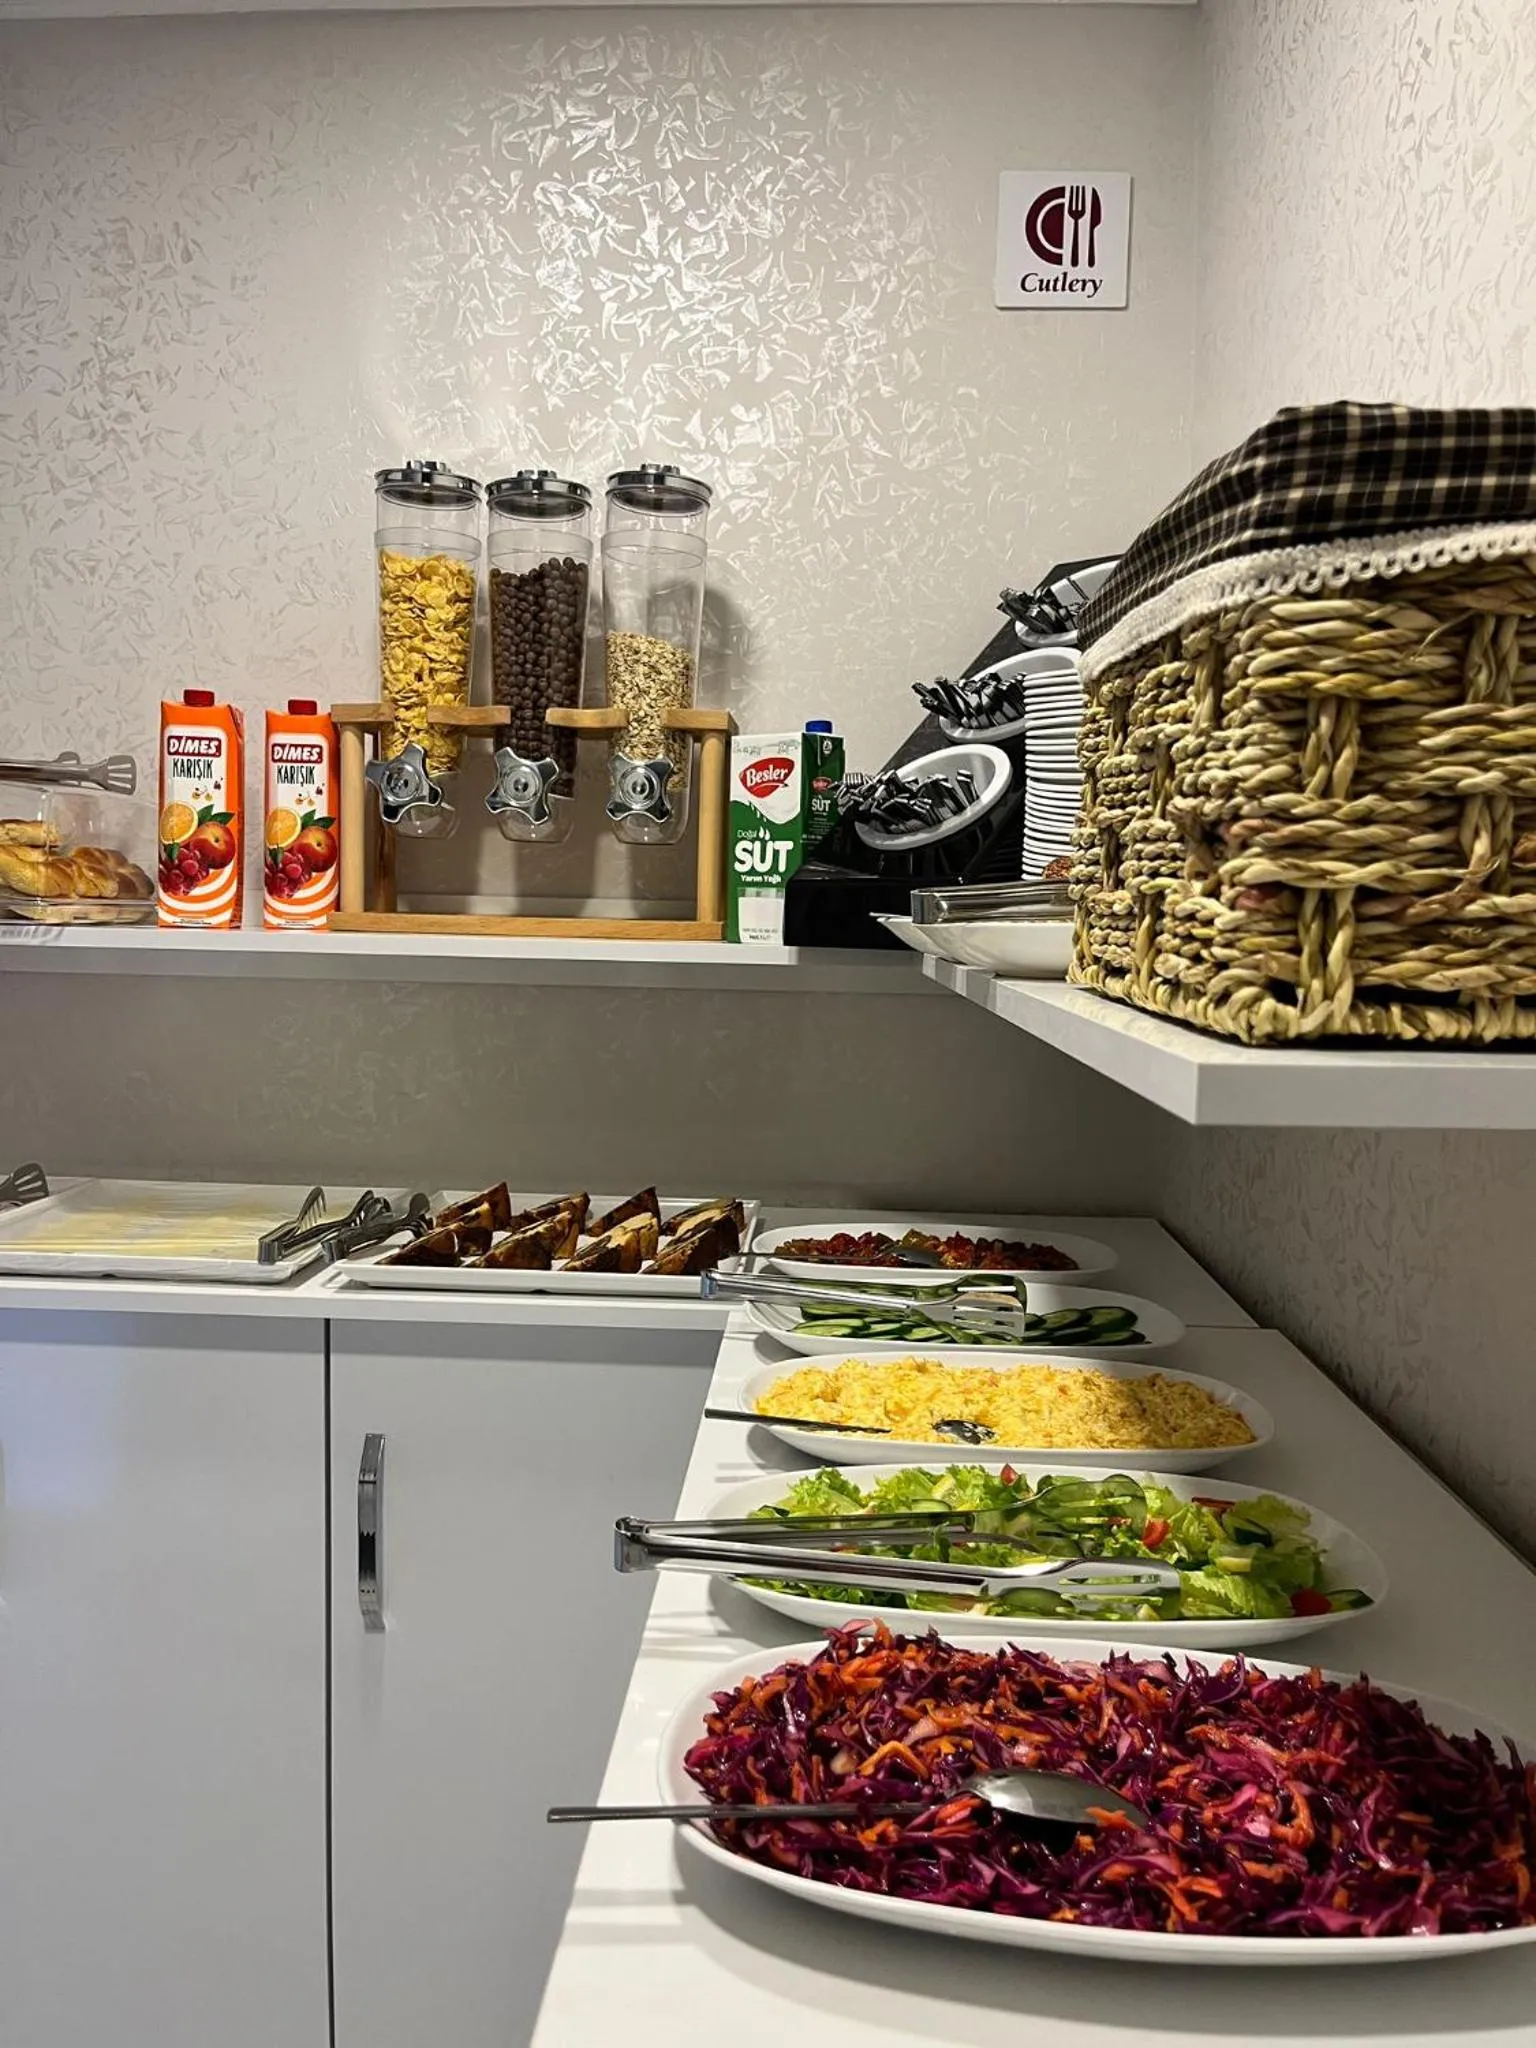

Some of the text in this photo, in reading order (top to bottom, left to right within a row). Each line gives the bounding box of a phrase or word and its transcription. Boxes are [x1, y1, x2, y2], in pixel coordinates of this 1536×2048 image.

[1020, 271, 1103, 299] Cutlery
[172, 758, 213, 780] KARIŞIK
[276, 765, 315, 787] KARIŞIK
[746, 764, 788, 787] Besler
